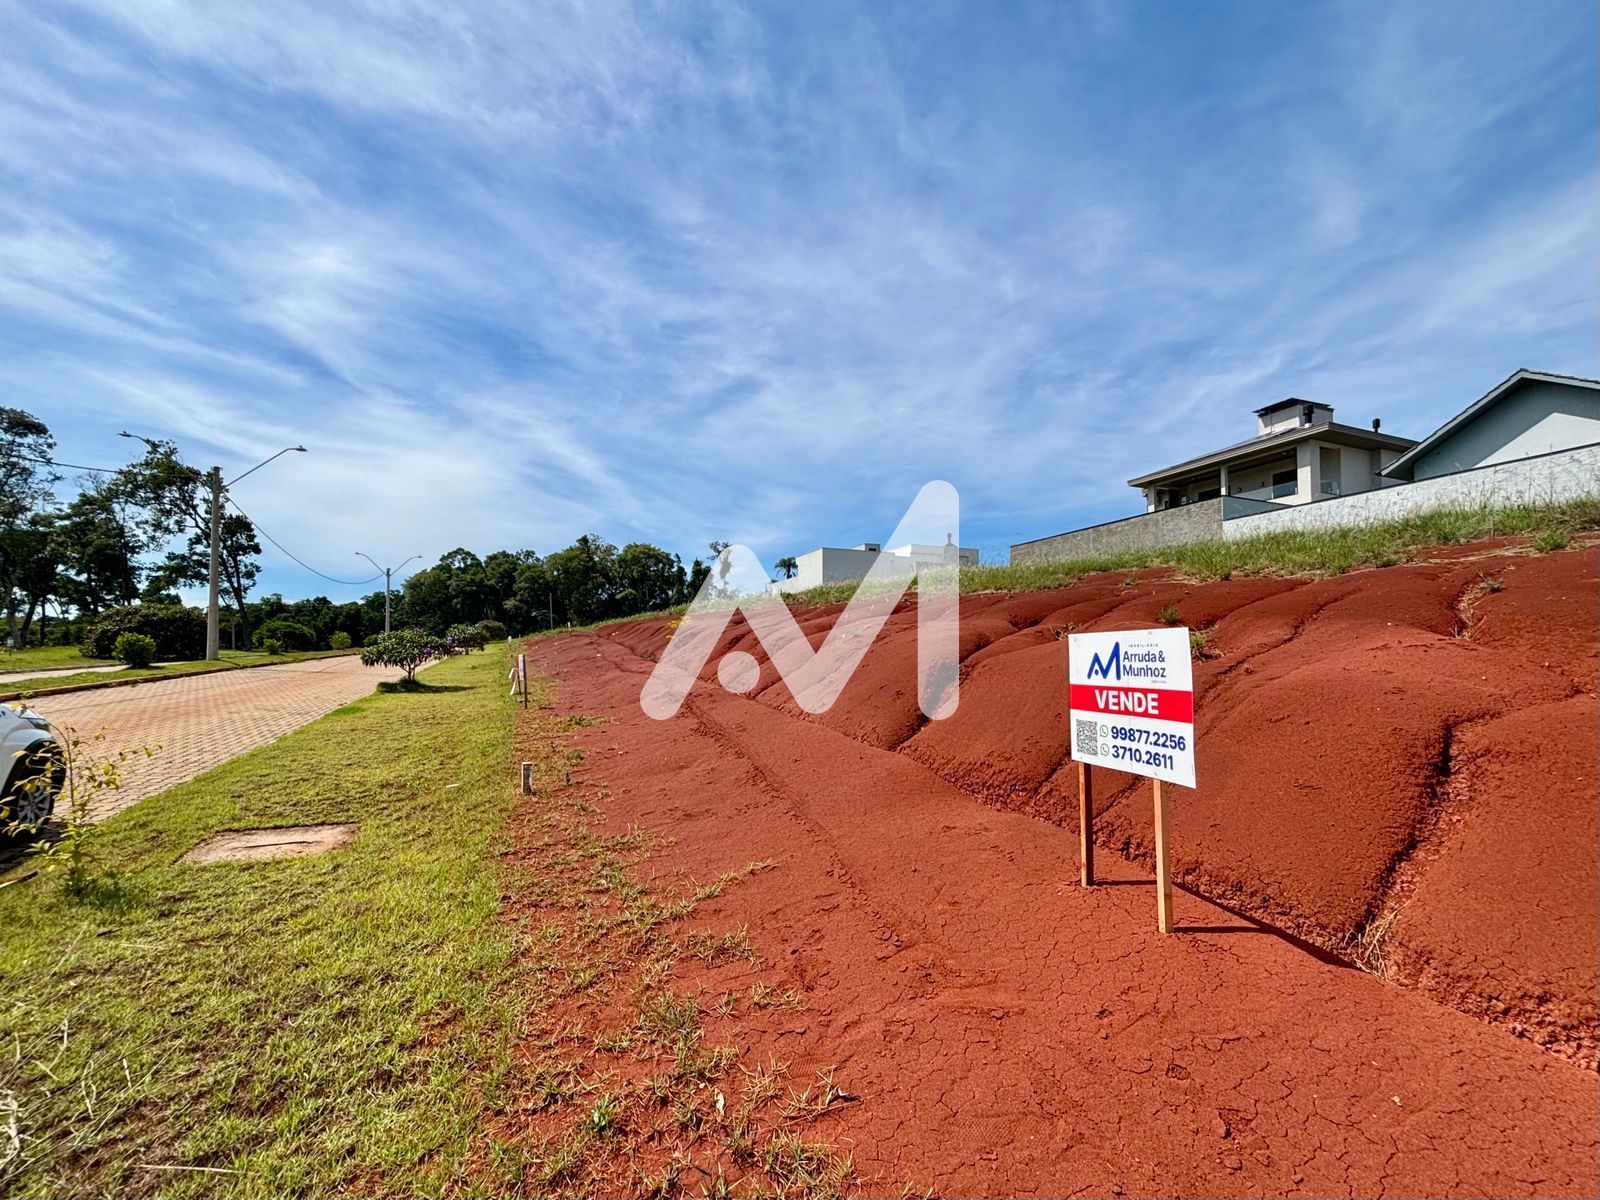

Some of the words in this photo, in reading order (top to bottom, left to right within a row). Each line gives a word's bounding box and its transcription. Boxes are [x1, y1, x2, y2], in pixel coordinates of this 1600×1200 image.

[1122, 651, 1157, 663] Arruda
[1158, 650, 1166, 663] &
[1122, 664, 1167, 678] Munhoz
[1094, 689, 1159, 715] VENDE
[1111, 726, 1186, 751] 99877.2256
[1111, 745, 1174, 770] 3710.2611
